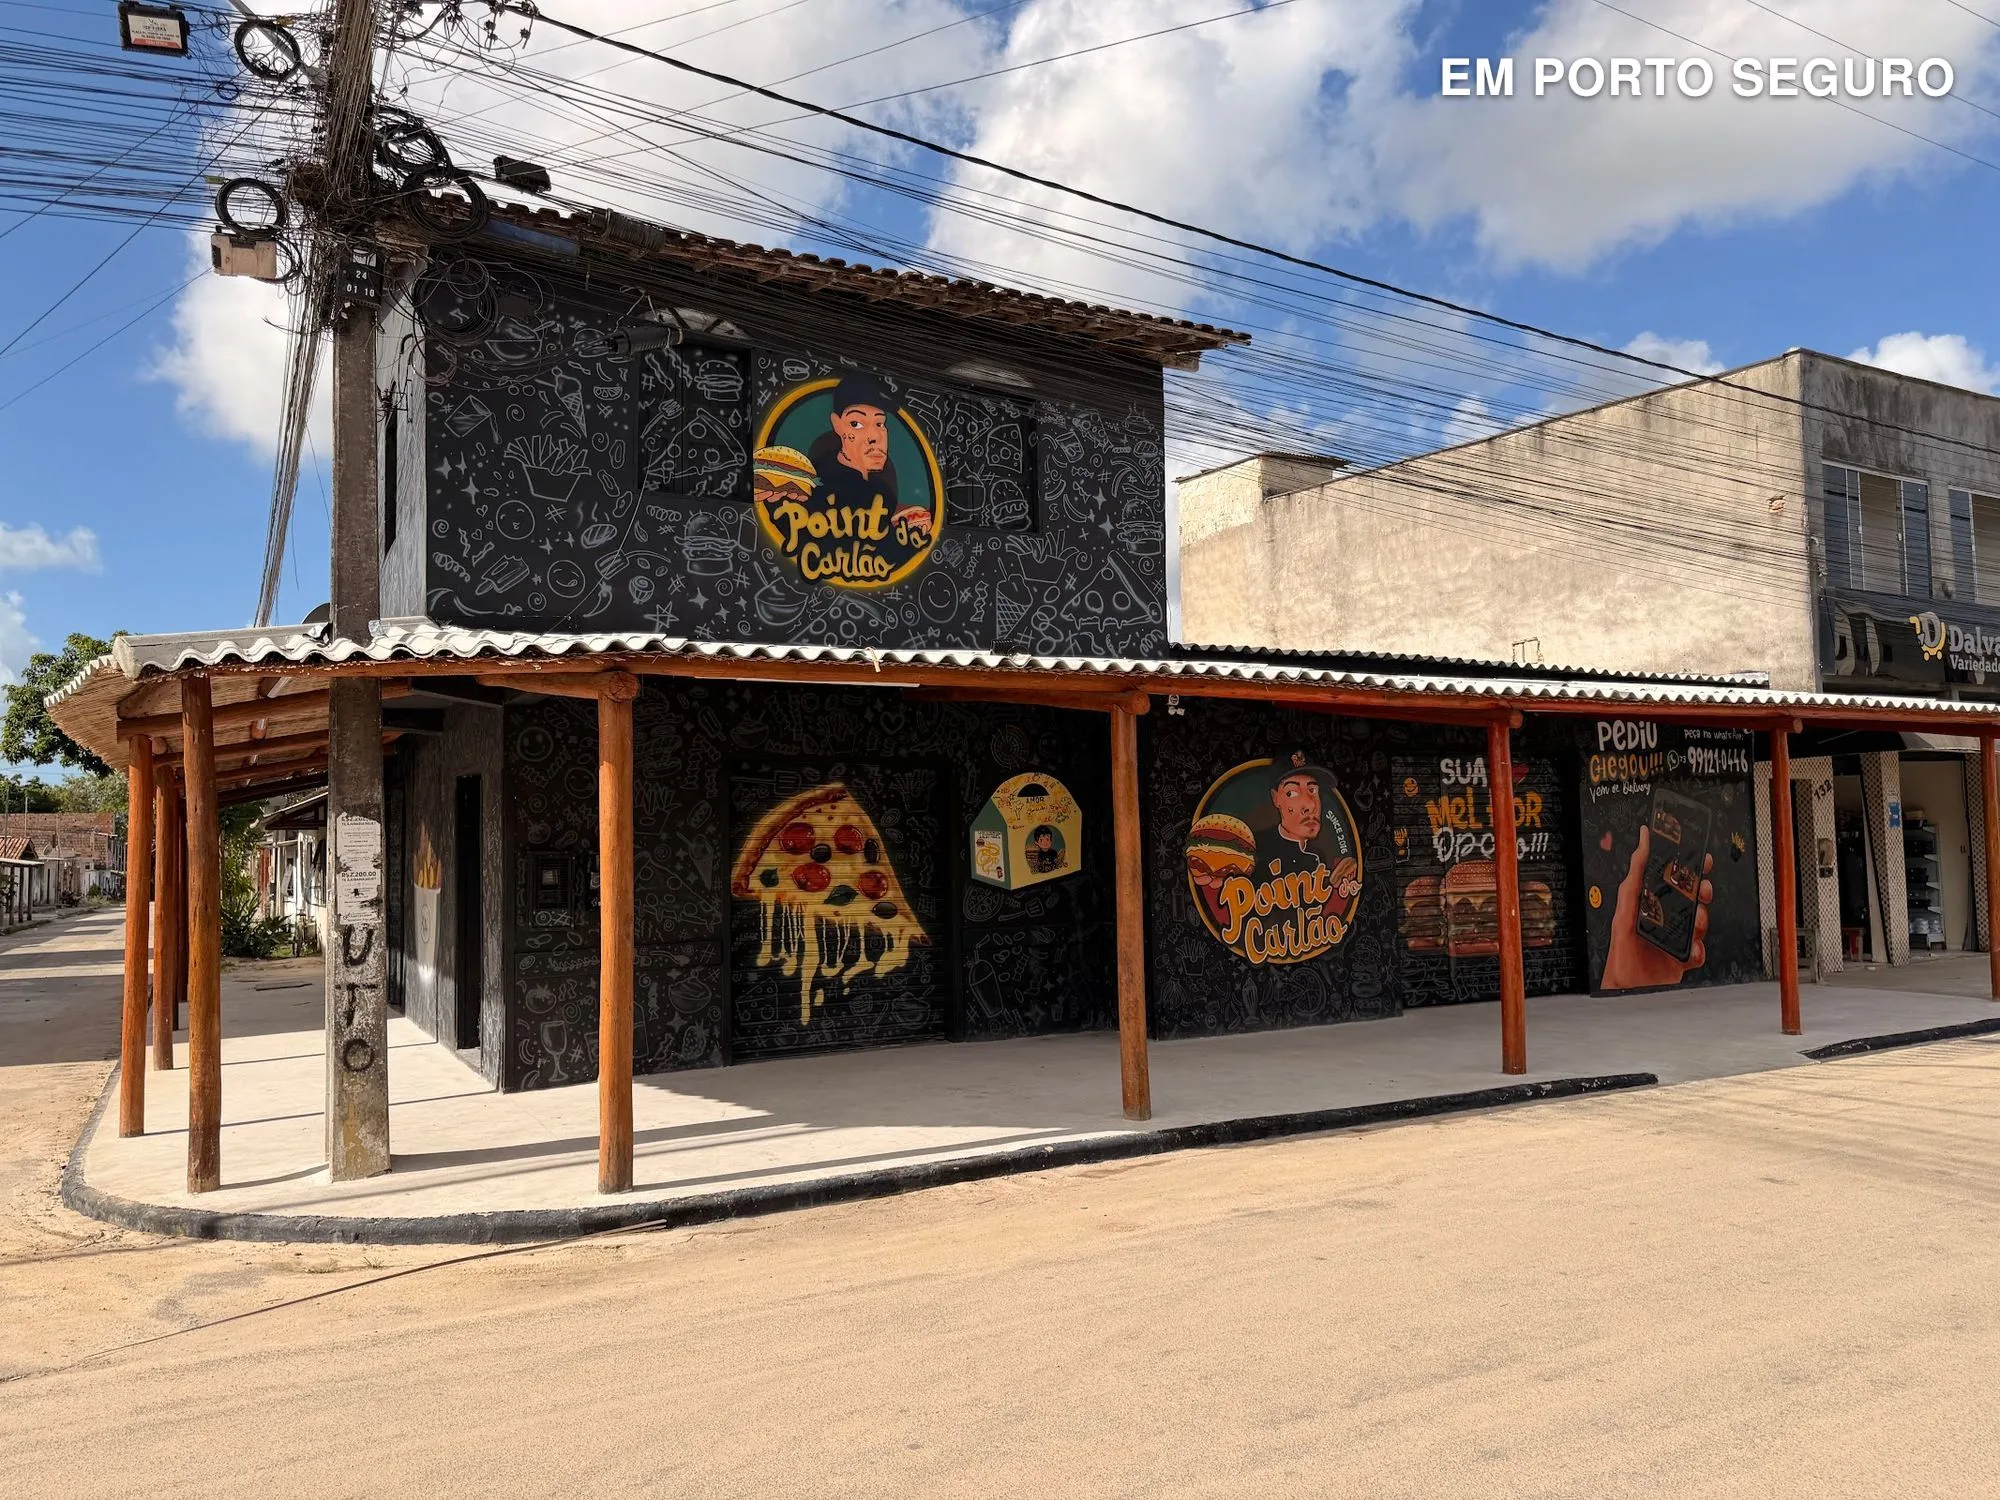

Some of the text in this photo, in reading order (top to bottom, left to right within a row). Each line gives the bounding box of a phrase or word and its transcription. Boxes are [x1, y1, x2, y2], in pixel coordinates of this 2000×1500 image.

[346, 283, 375, 298] 01 10
[355, 270, 368, 280] 24
[774, 494, 889, 552] Point
[801, 541, 895, 581] Carlão
[1439, 757, 1488, 788] SUA
[1813, 779, 1832, 799] 132
[1325, 810, 1349, 854] SINCE 2016
[1219, 857, 1363, 945] Point do
[1245, 905, 1348, 965] Carlão
